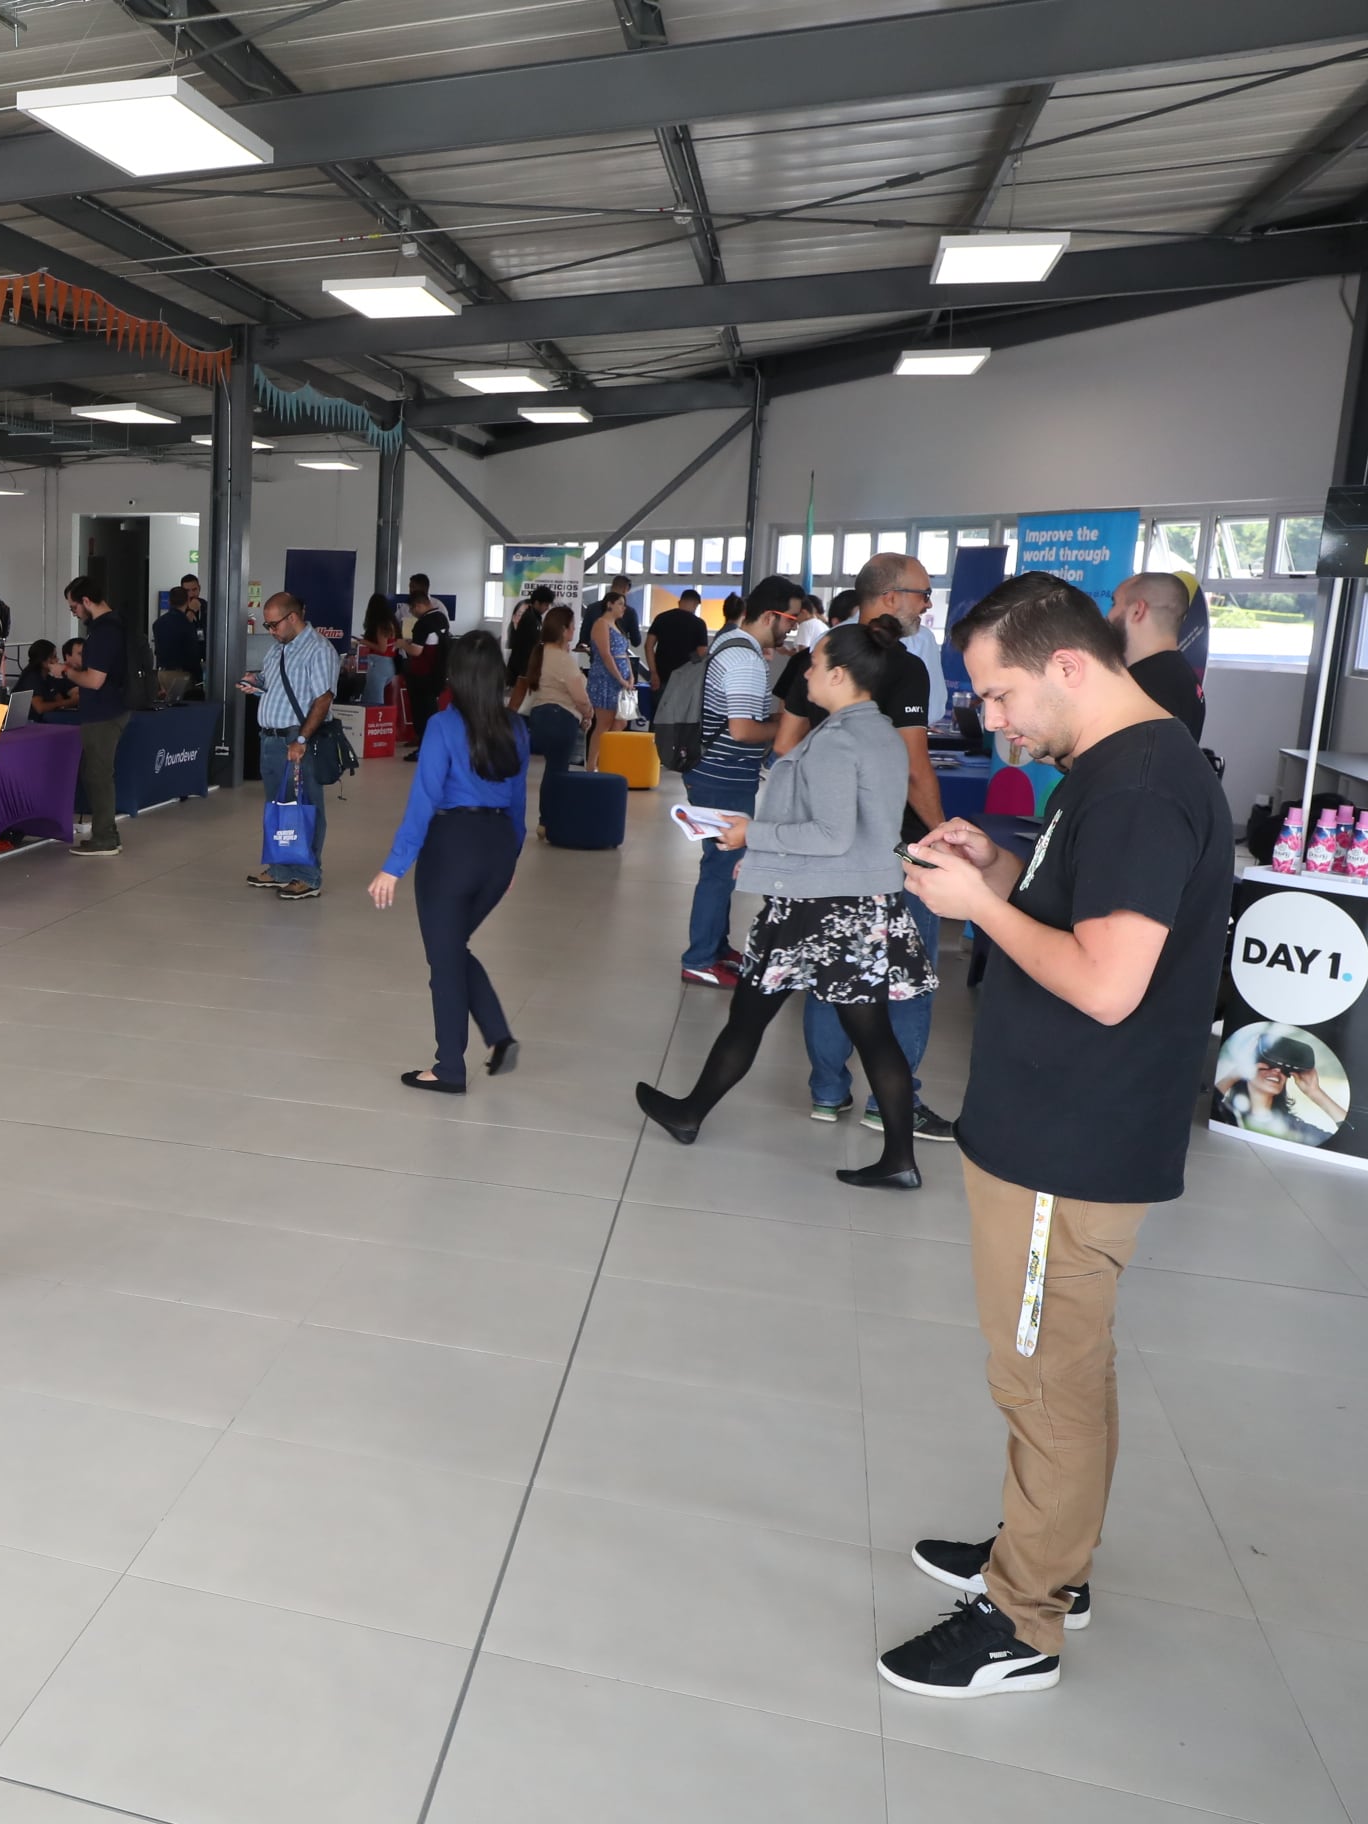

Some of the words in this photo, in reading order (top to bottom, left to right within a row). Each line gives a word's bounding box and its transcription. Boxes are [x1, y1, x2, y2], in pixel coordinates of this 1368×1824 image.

[1025, 529, 1073, 545] Improve
[1077, 526, 1099, 540] the
[1023, 547, 1056, 562] world
[1059, 545, 1110, 564] through
[165, 748, 198, 767] foundever
[1242, 936, 1323, 975] DAY
[1328, 951, 1353, 982] 1.
[988, 1650, 1008, 1660] PUMA
